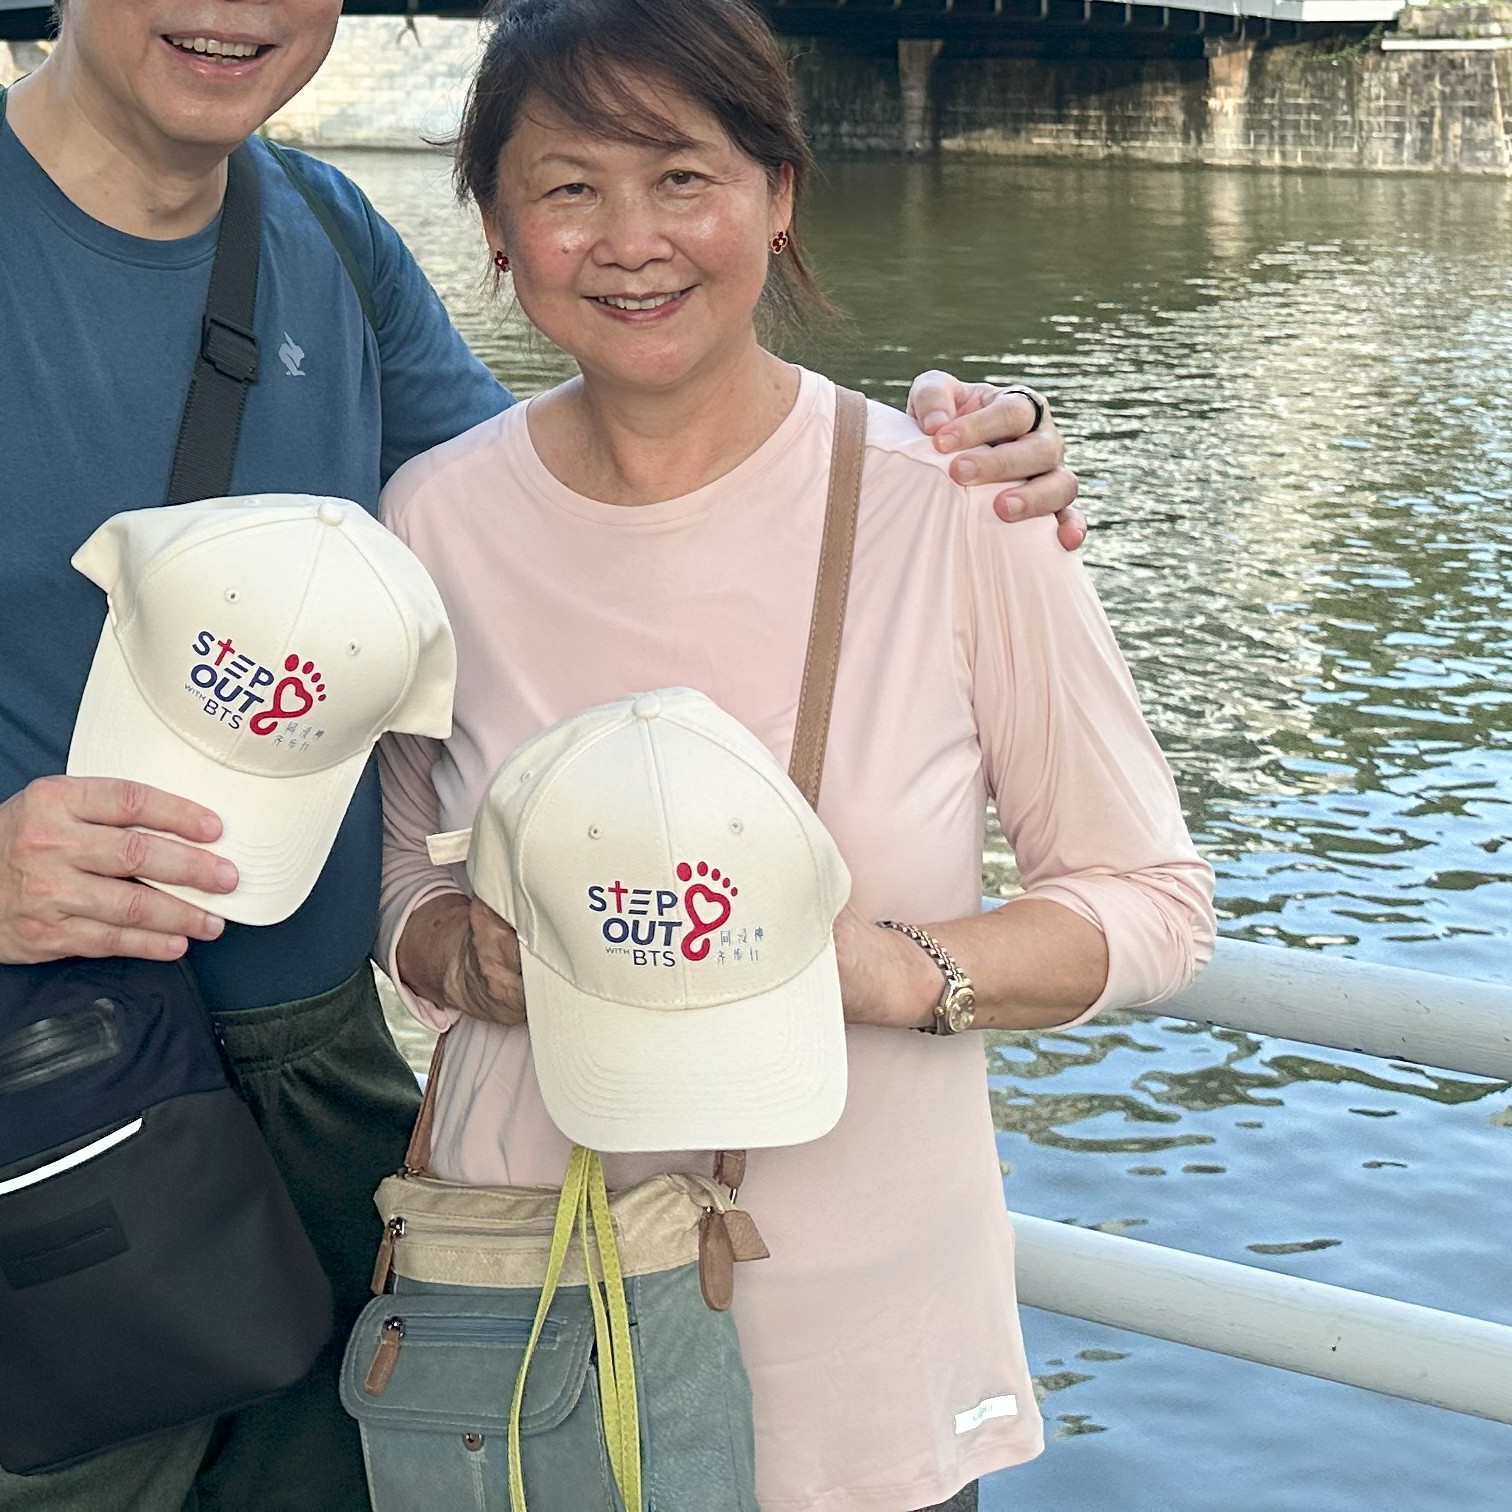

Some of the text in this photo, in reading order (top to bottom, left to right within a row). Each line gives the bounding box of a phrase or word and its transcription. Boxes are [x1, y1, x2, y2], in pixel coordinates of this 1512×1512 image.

[190, 663, 265, 714] OUT
[203, 698, 243, 730] BTS
[602, 917, 683, 947] OUT
[605, 946, 676, 967] WITH BTS
